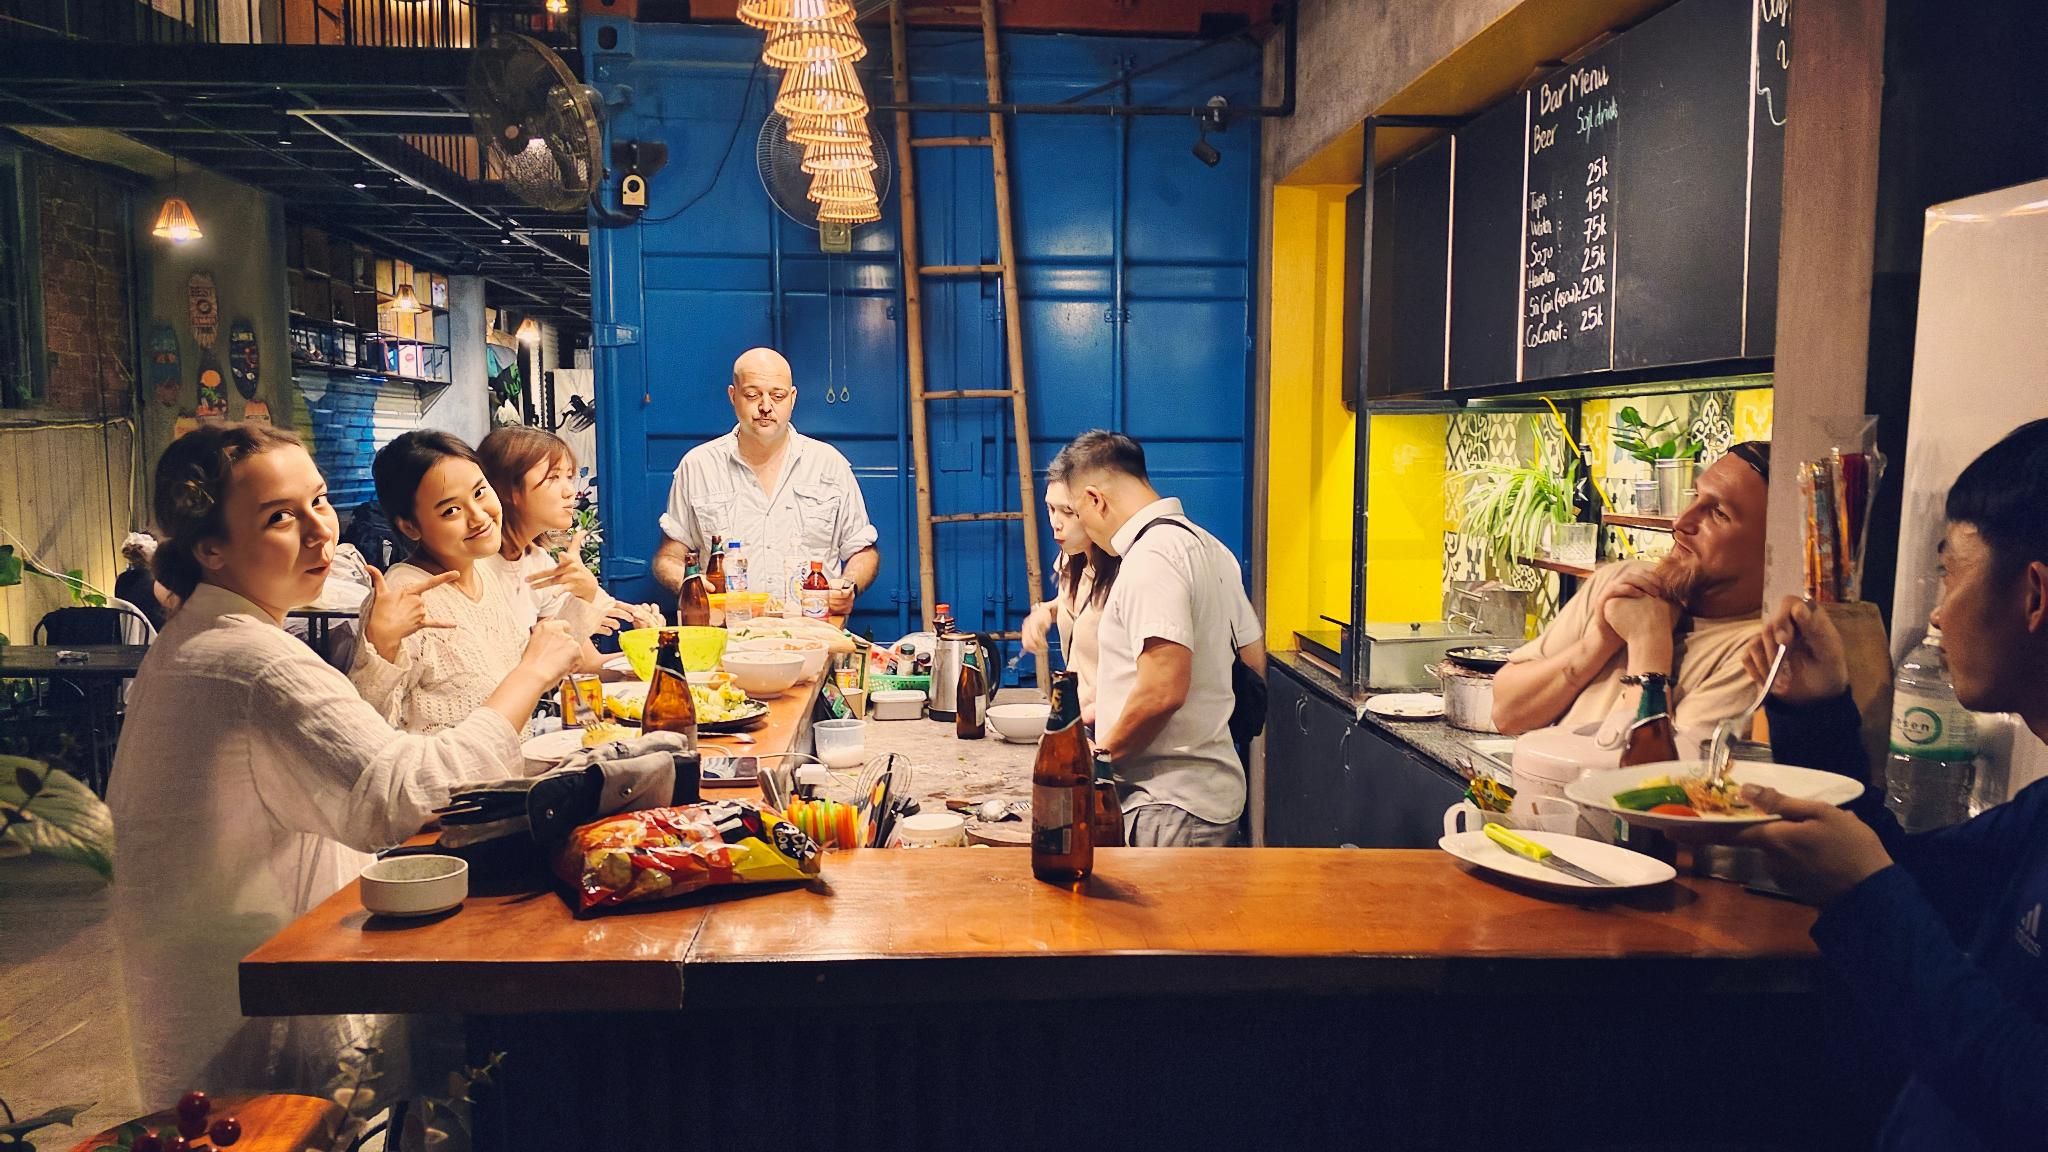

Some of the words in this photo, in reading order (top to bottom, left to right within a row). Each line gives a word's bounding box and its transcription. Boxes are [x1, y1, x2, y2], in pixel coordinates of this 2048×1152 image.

[1540, 83, 1568, 116] Bar
[1570, 66, 1610, 102] Menu
[1533, 124, 1559, 155] Beer
[1586, 155, 1609, 186] 25k
[1585, 186, 1609, 212] 15k
[1583, 213, 1608, 244] 75k
[1581, 244, 1607, 273] 25k
[1581, 273, 1606, 301] 20k
[1580, 303, 1604, 332] 25k
